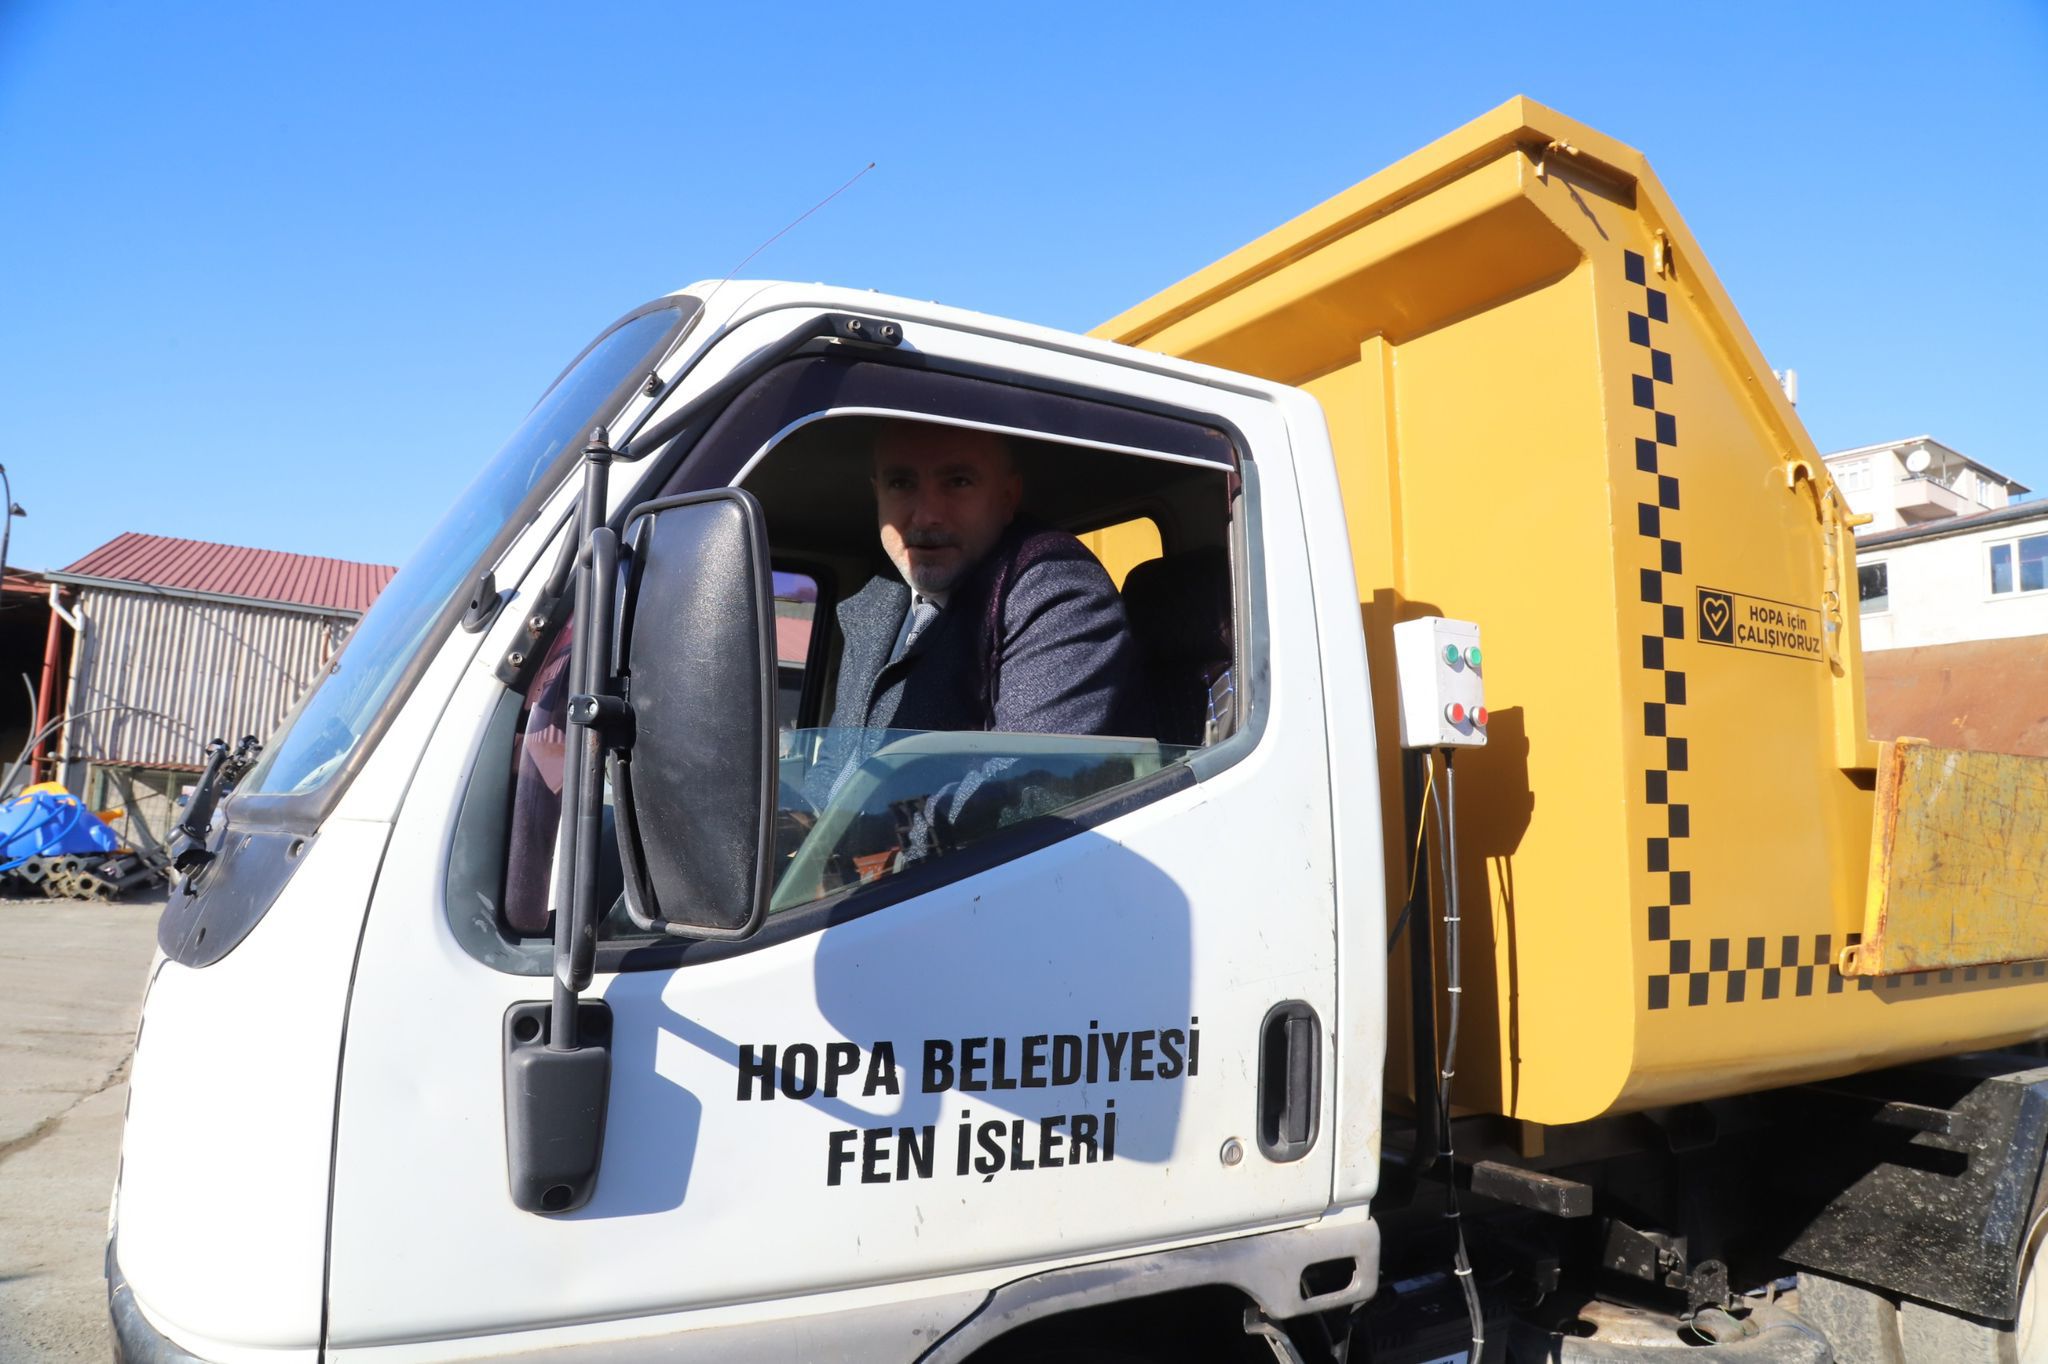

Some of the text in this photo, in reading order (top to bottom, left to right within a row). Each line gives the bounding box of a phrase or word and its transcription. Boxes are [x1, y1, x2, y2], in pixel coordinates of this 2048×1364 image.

[1737, 624, 1820, 653] ÇALIŞIYORUZ
[1750, 605, 1807, 631] HOPA için
[737, 1016, 1201, 1101] HOPA BELEDİYESİ
[827, 1099, 1117, 1186] FEN İŞLERİ
